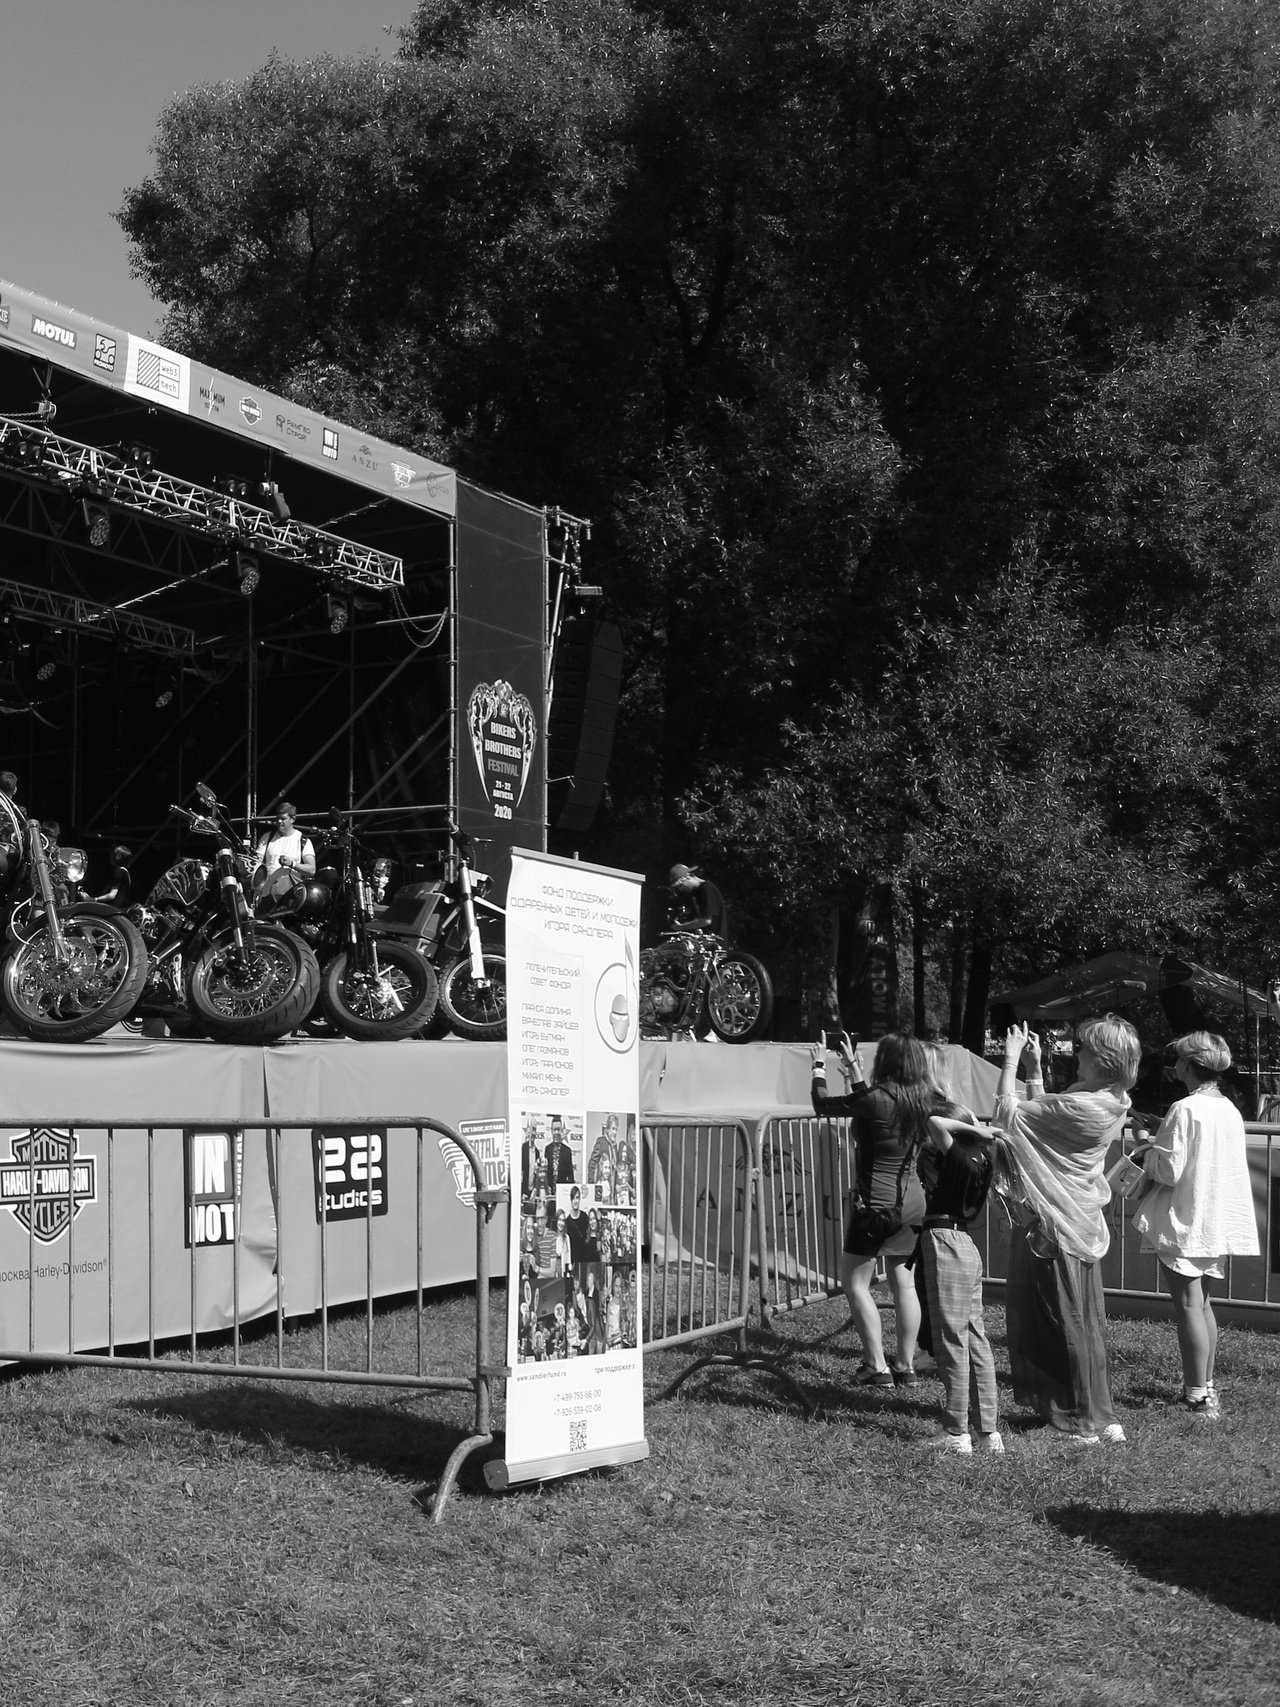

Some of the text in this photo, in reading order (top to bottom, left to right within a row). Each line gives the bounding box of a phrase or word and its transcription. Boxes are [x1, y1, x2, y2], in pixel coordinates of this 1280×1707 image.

[33, 318, 76, 348] MOTUL
[94, 358, 114, 372] PROMOTO
[161, 364, 178, 377] web3
[160, 381, 177, 393] tech
[351, 454, 379, 471] ANZU
[490, 721, 517, 740] BIKERS
[484, 738, 522, 760] BROTHERS
[487, 758, 519, 777] FESTIVAL
[492, 788, 514, 801] АВГУСТА
[494, 803, 513, 820] 2020
[542, 885, 614, 908] ФОНД ПОДДЕРЖКИ
[509, 896, 563, 915] ОДАРЕННЫХ
[564, 906, 591, 920] ДЕТЕЙ
[592, 911, 599, 921] И
[544, 919, 614, 940] ИГОРЯ САНДЛЕРА
[525, 962, 581, 978] ПОПЕЧИТЕЛЬСКИЙ
[530, 976, 572, 990] СОВЕТ ФОНДА
[544, 1005, 572, 1016] ДОЛИНА
[553, 1019, 579, 1031] ЗАЙЦЕВ
[536, 1045, 570, 1057] ГАЗМАНОВ
[545, 1073, 563, 1083] МЕНЬ
[540, 1086, 570, 1097] САНДЛЕР
[22, 1134, 68, 1162] MOTOR
[194, 1136, 226, 1195] IN
[318, 1134, 383, 1184] 22
[23, 1200, 70, 1234] CYCLES
[189, 1203, 241, 1244] MOT
